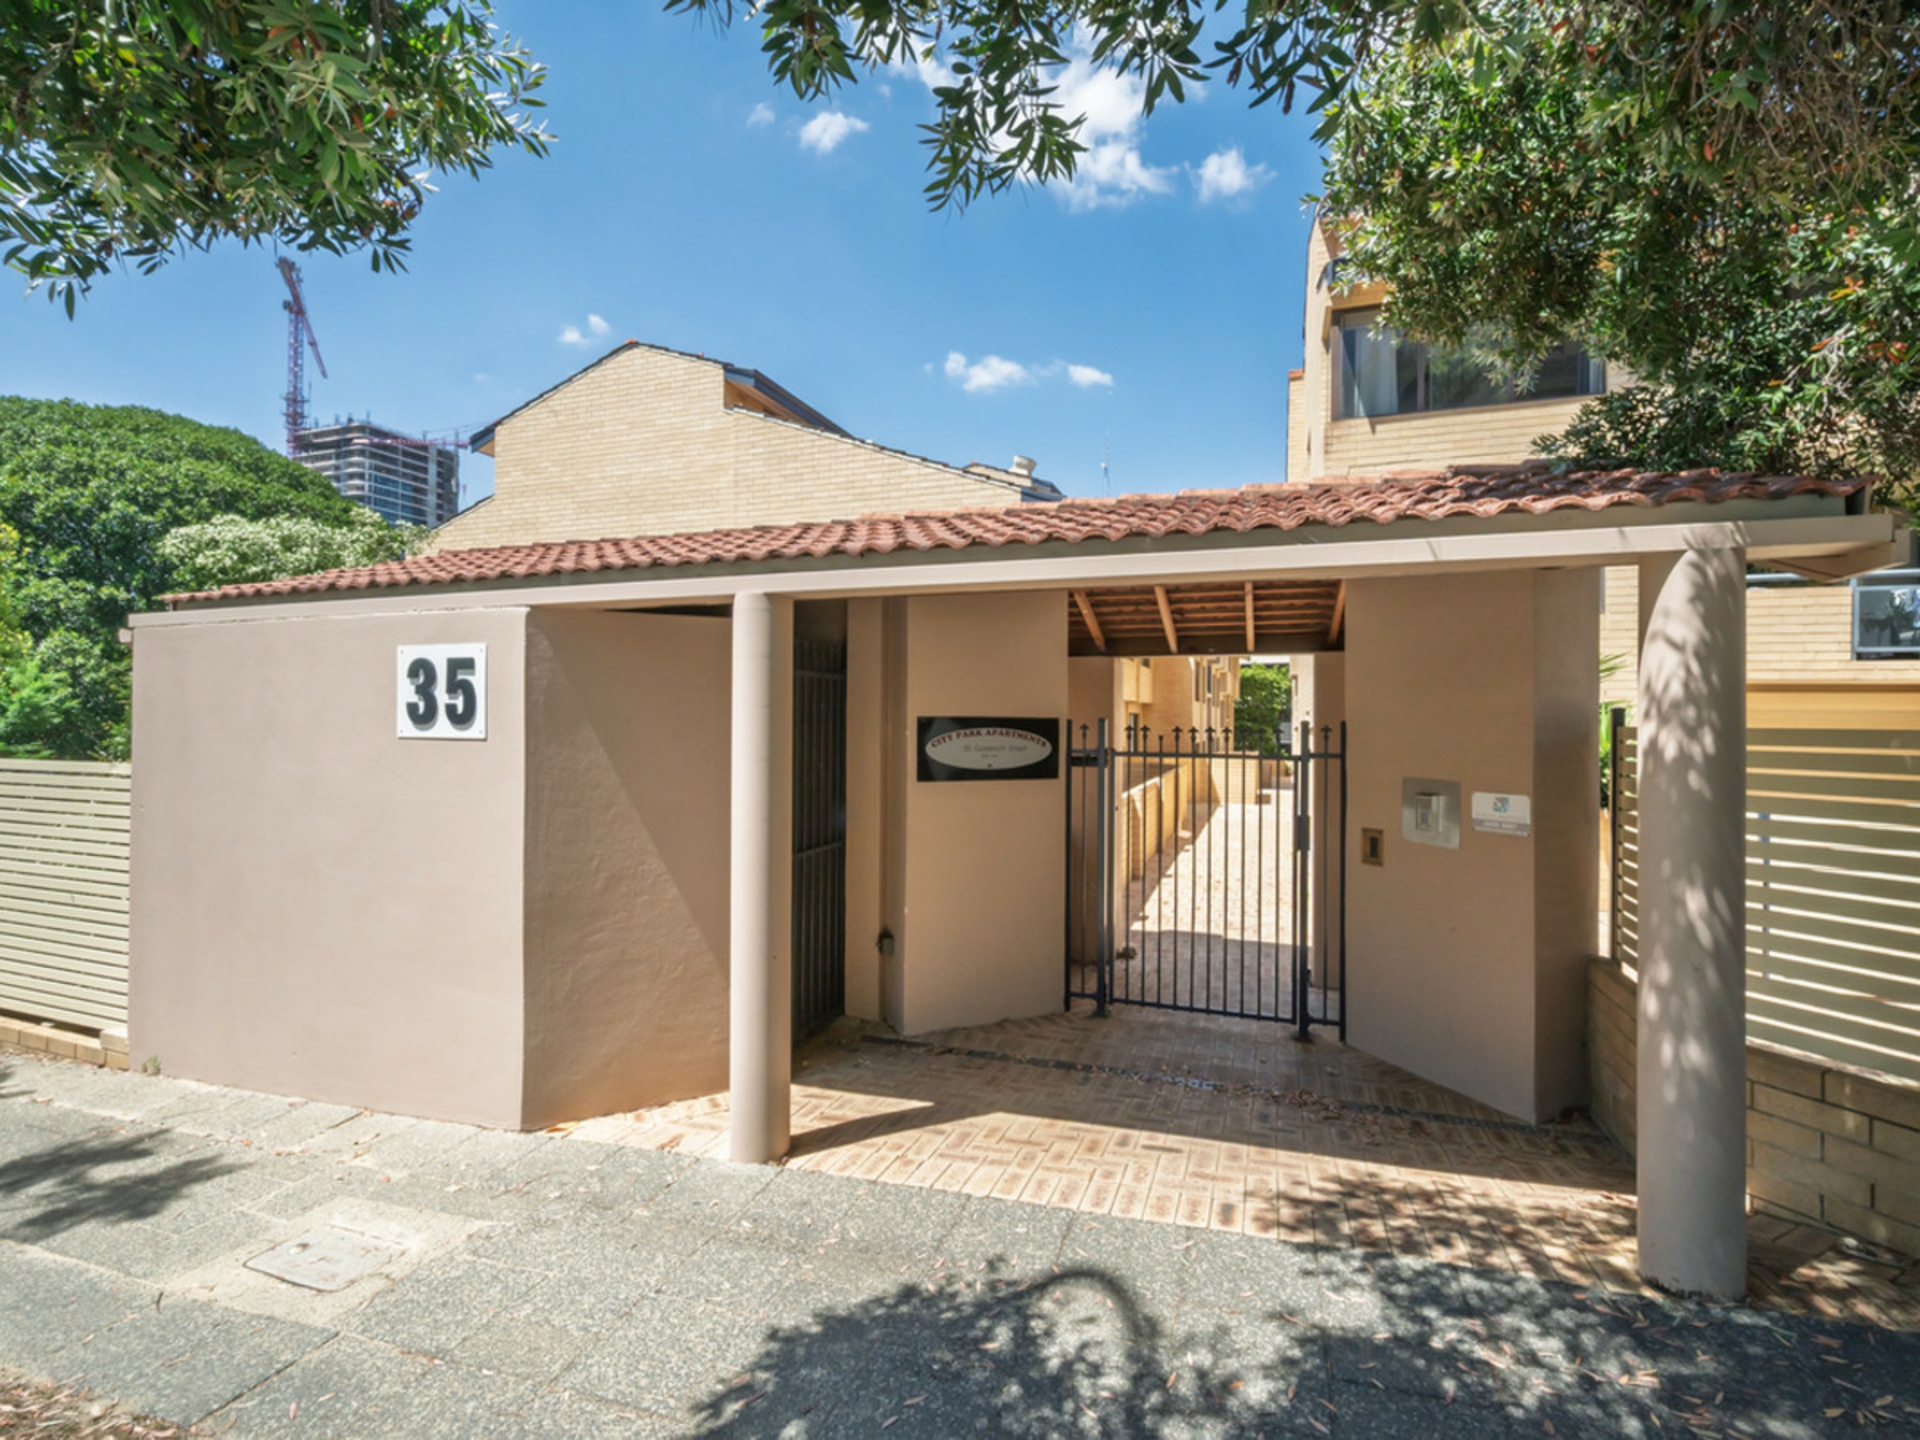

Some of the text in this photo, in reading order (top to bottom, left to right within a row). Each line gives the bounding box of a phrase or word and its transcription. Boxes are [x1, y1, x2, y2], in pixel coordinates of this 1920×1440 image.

[406, 657, 477, 731] 35
[930, 728, 1047, 748] CITY PARK APARTMENTS
